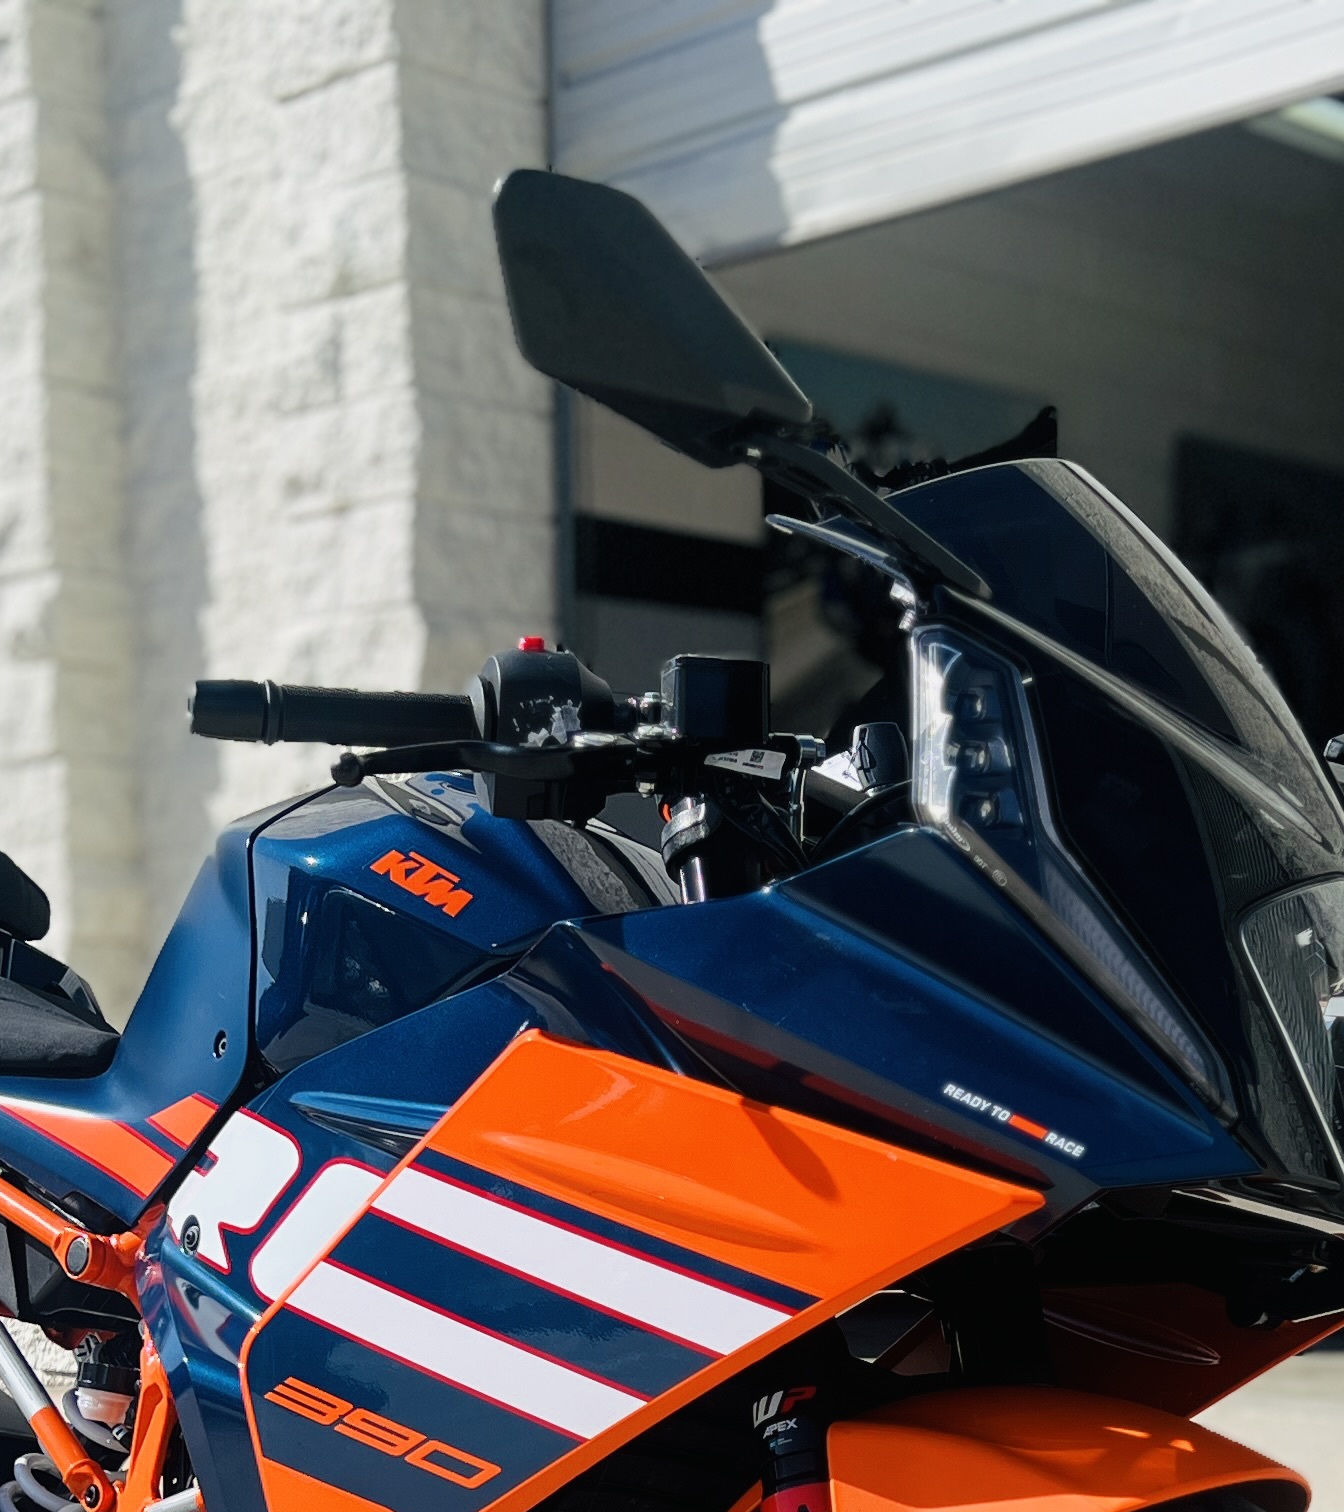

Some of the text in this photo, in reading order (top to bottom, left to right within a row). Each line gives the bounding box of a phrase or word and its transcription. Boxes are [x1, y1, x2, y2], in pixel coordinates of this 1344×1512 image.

[370, 850, 474, 917] KTM
[943, 1083, 1085, 1157] READY TO RACE
[264, 1376, 502, 1490] 390
[753, 1386, 816, 1429] WP
[763, 1418, 798, 1440] APEX
